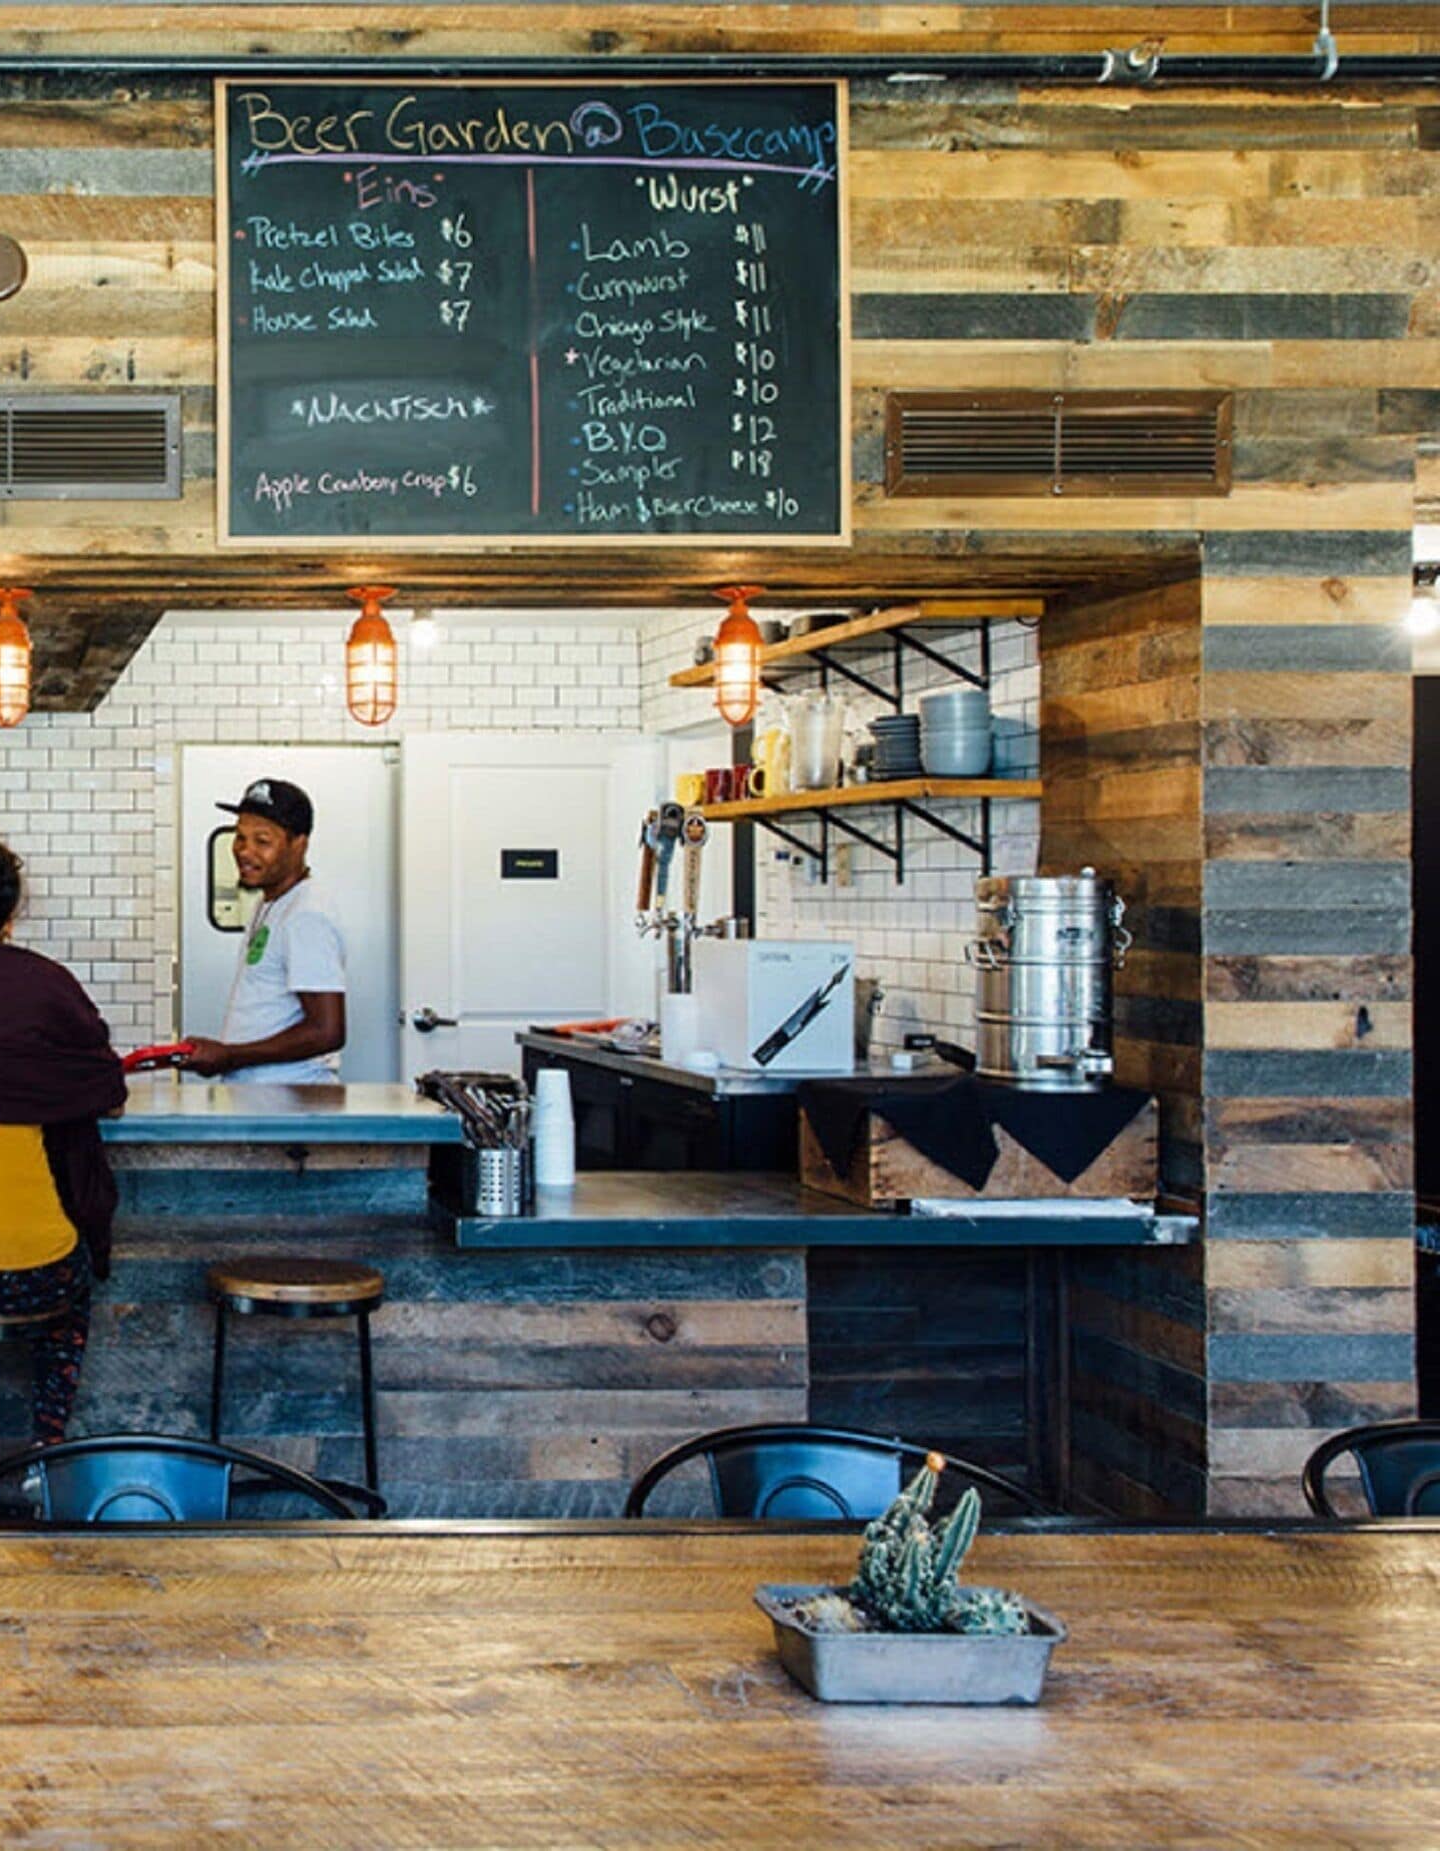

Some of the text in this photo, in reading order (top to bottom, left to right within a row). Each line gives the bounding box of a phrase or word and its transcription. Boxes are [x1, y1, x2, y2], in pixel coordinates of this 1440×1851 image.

[236, 91, 374, 154] Beer
[385, 96, 573, 155] Garden
[626, 102, 838, 170] Basecamp
[648, 172, 740, 214] Wurst
[247, 216, 339, 250] Pretzel
[440, 213, 473, 248] $6
[580, 222, 691, 262] Lamb
[436, 258, 473, 293] $7
[439, 299, 471, 332] $7
[730, 412, 778, 446] $12
[254, 471, 310, 513] Apple
